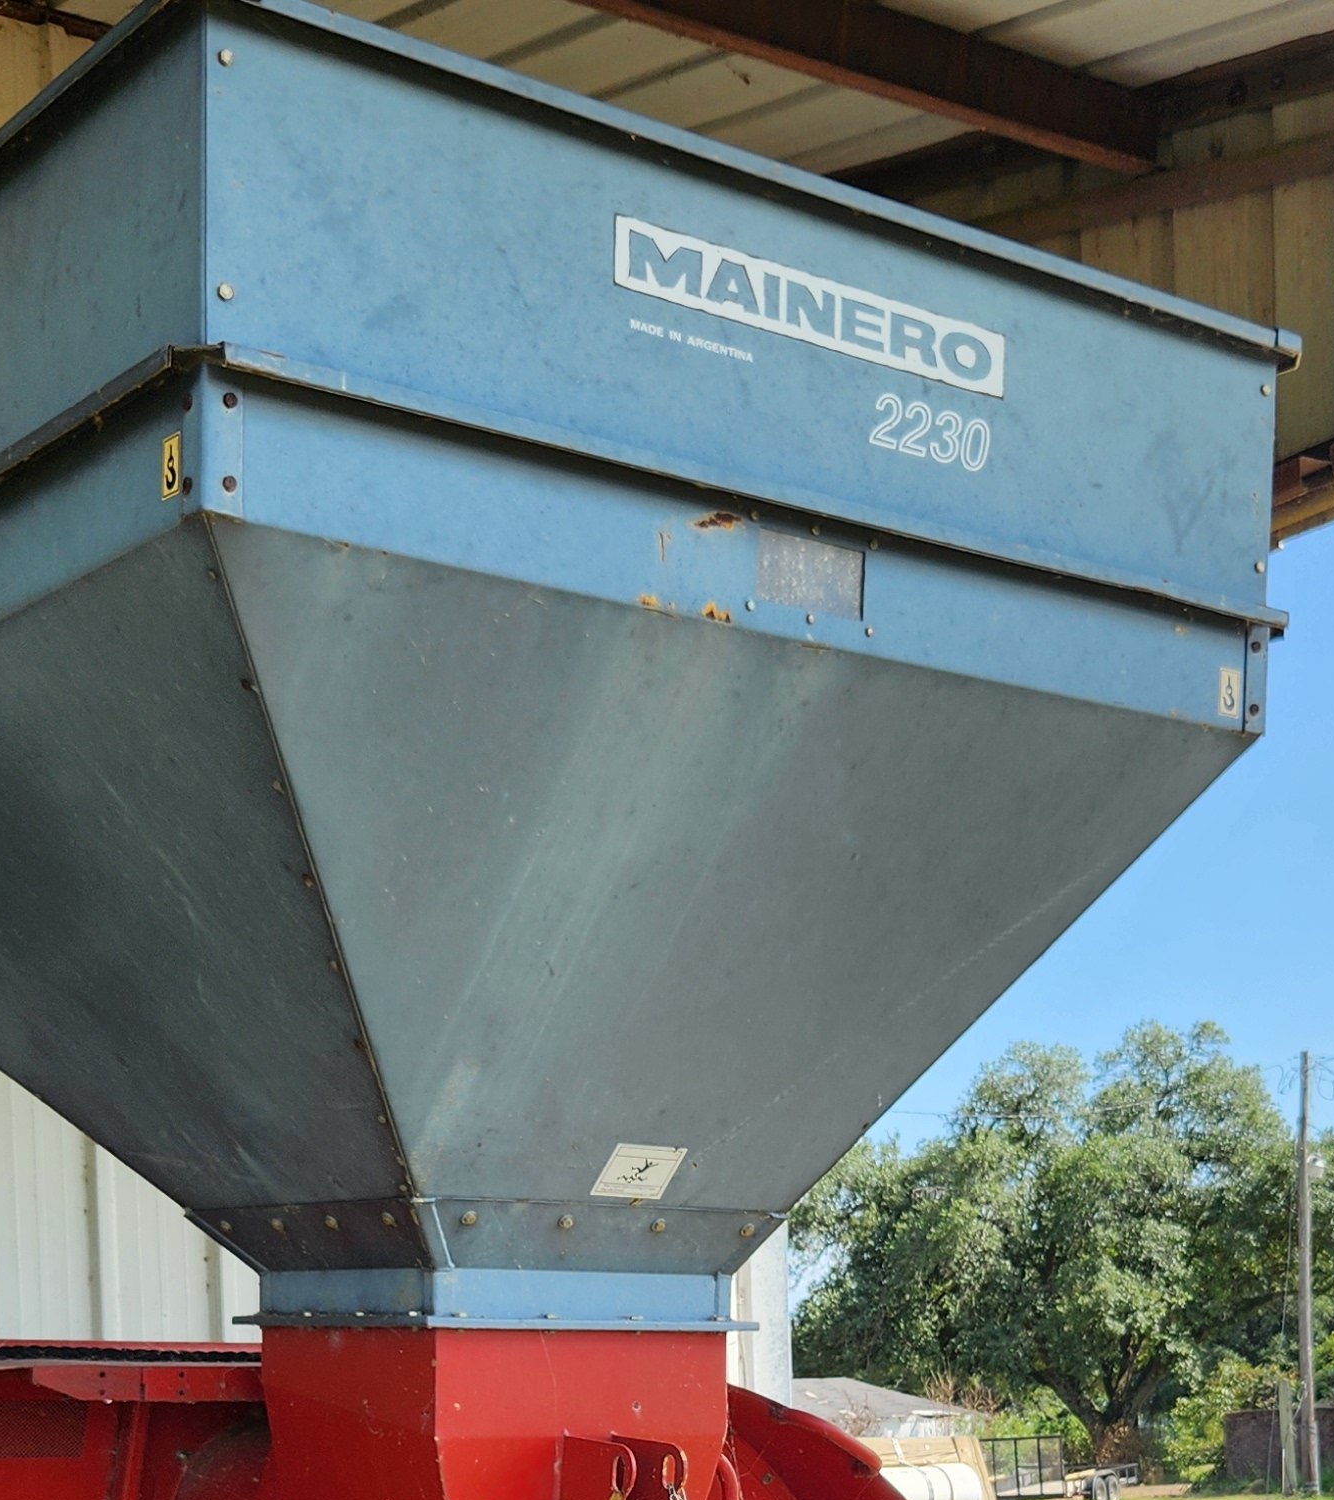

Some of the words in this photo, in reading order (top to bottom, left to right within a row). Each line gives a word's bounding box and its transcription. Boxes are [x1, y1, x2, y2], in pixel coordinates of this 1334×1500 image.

[628, 228, 993, 382] MAINERO
[630, 318, 664, 338] MADE
[669, 330, 682, 342] IN
[687, 335, 754, 363] ARGENTINA
[869, 393, 992, 473] 2230
